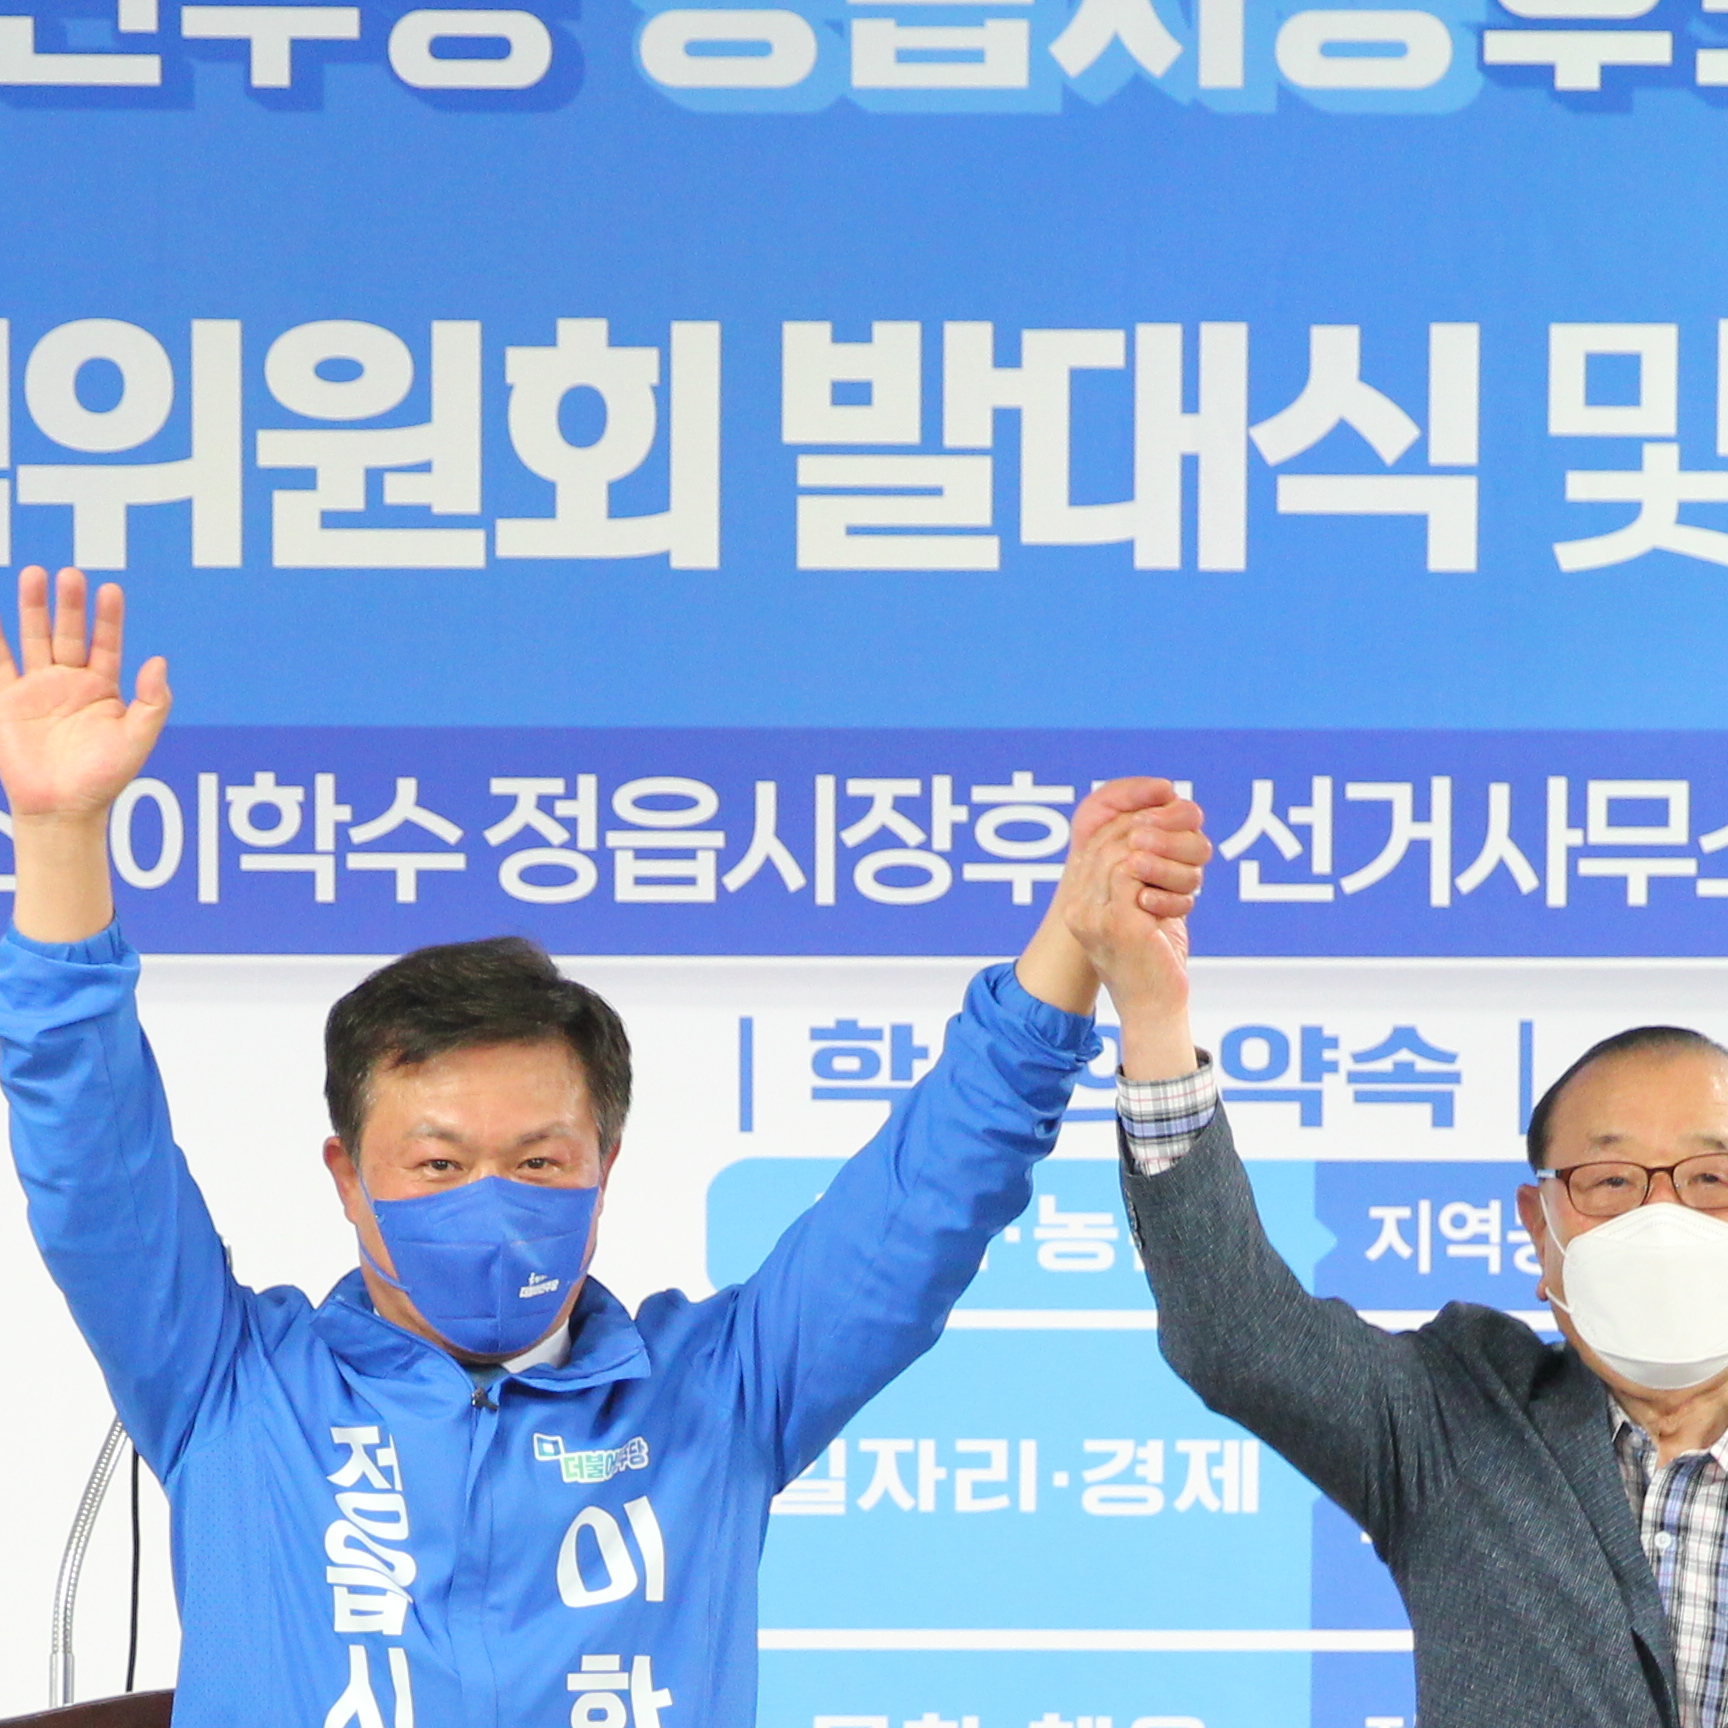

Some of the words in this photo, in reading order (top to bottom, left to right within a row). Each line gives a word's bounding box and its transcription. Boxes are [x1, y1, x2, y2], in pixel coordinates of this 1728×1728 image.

[782, 320, 1481, 573] 발대식
[110, 772, 466, 904] 이학수
[483, 771, 1194, 906] 정읍시장후
[1219, 1022, 1463, 1128] 약속
